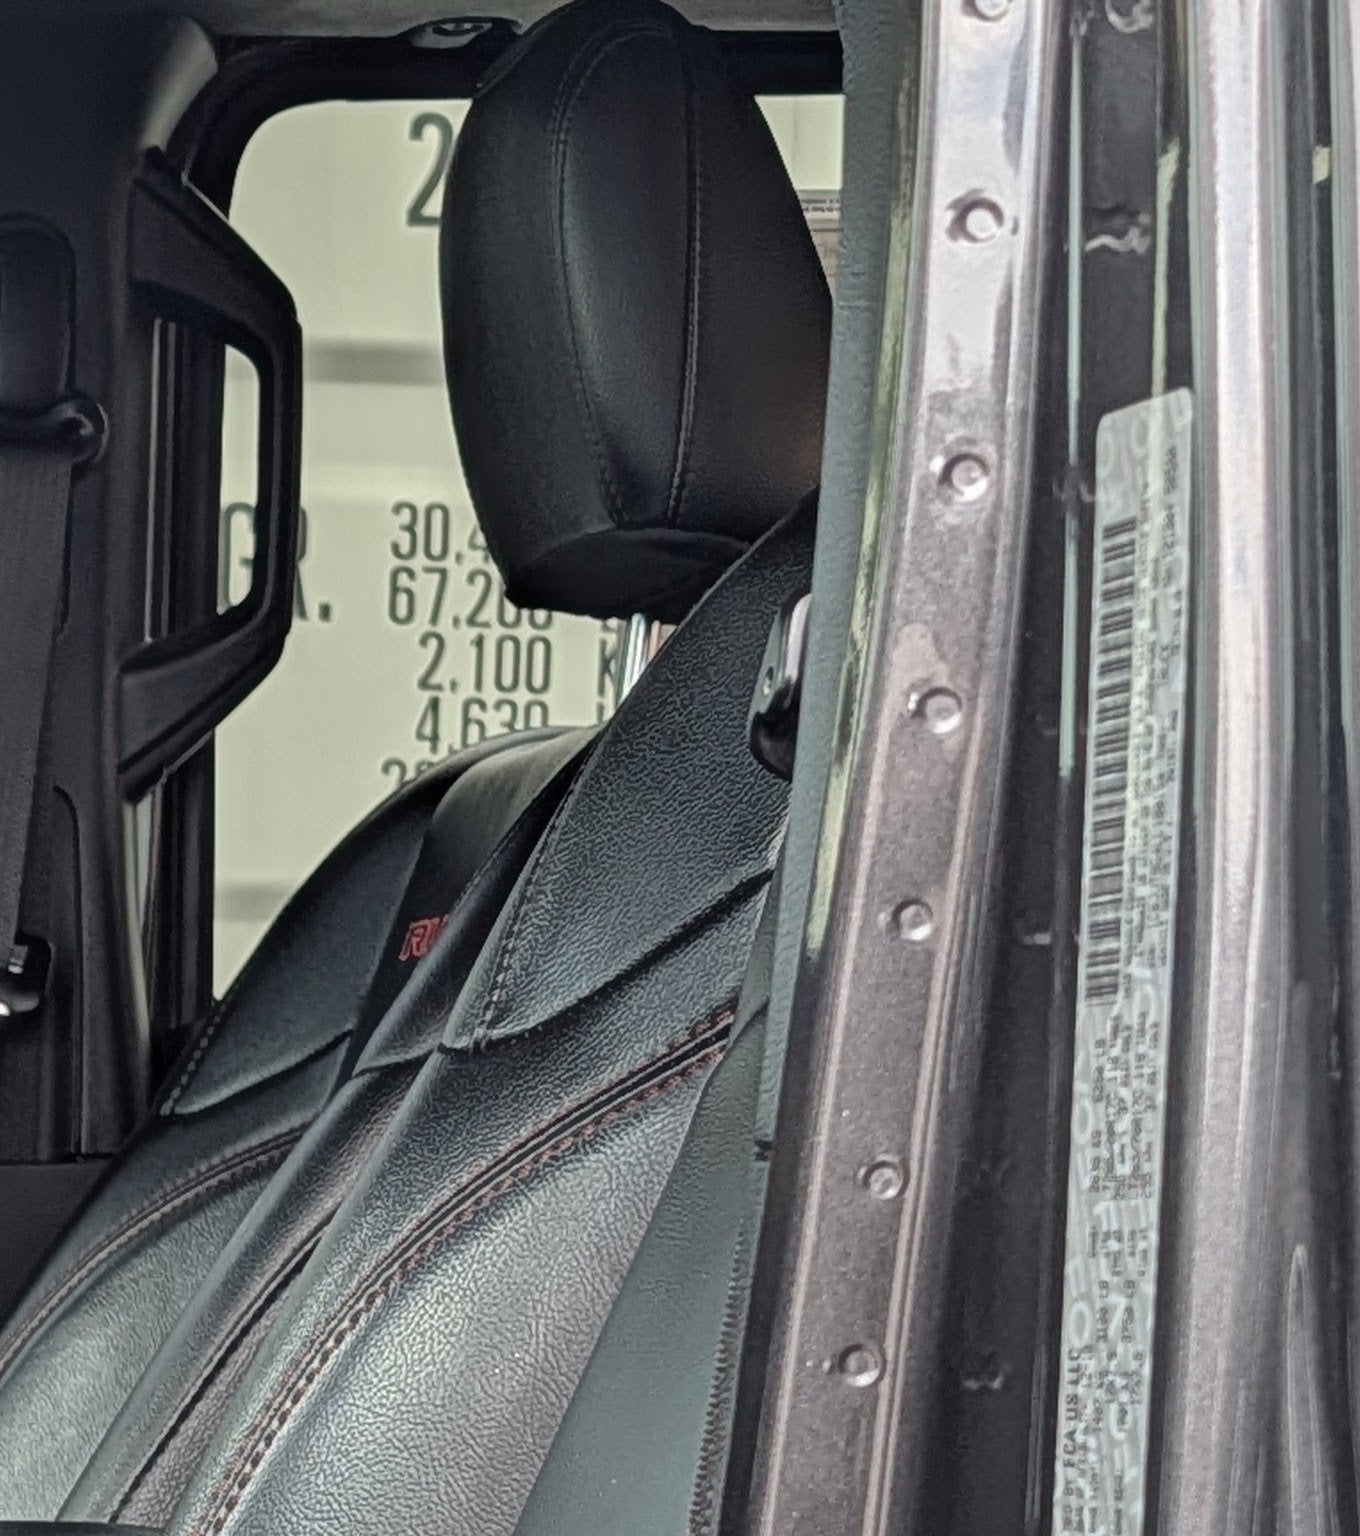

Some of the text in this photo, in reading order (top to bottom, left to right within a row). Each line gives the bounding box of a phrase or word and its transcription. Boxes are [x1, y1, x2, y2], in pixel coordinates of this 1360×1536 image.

[417, 631, 552, 693] 2.100
[1065, 1344, 1080, 1388] LLC
[1064, 1391, 1078, 1422] US
[1062, 1427, 1076, 1470] FCA
